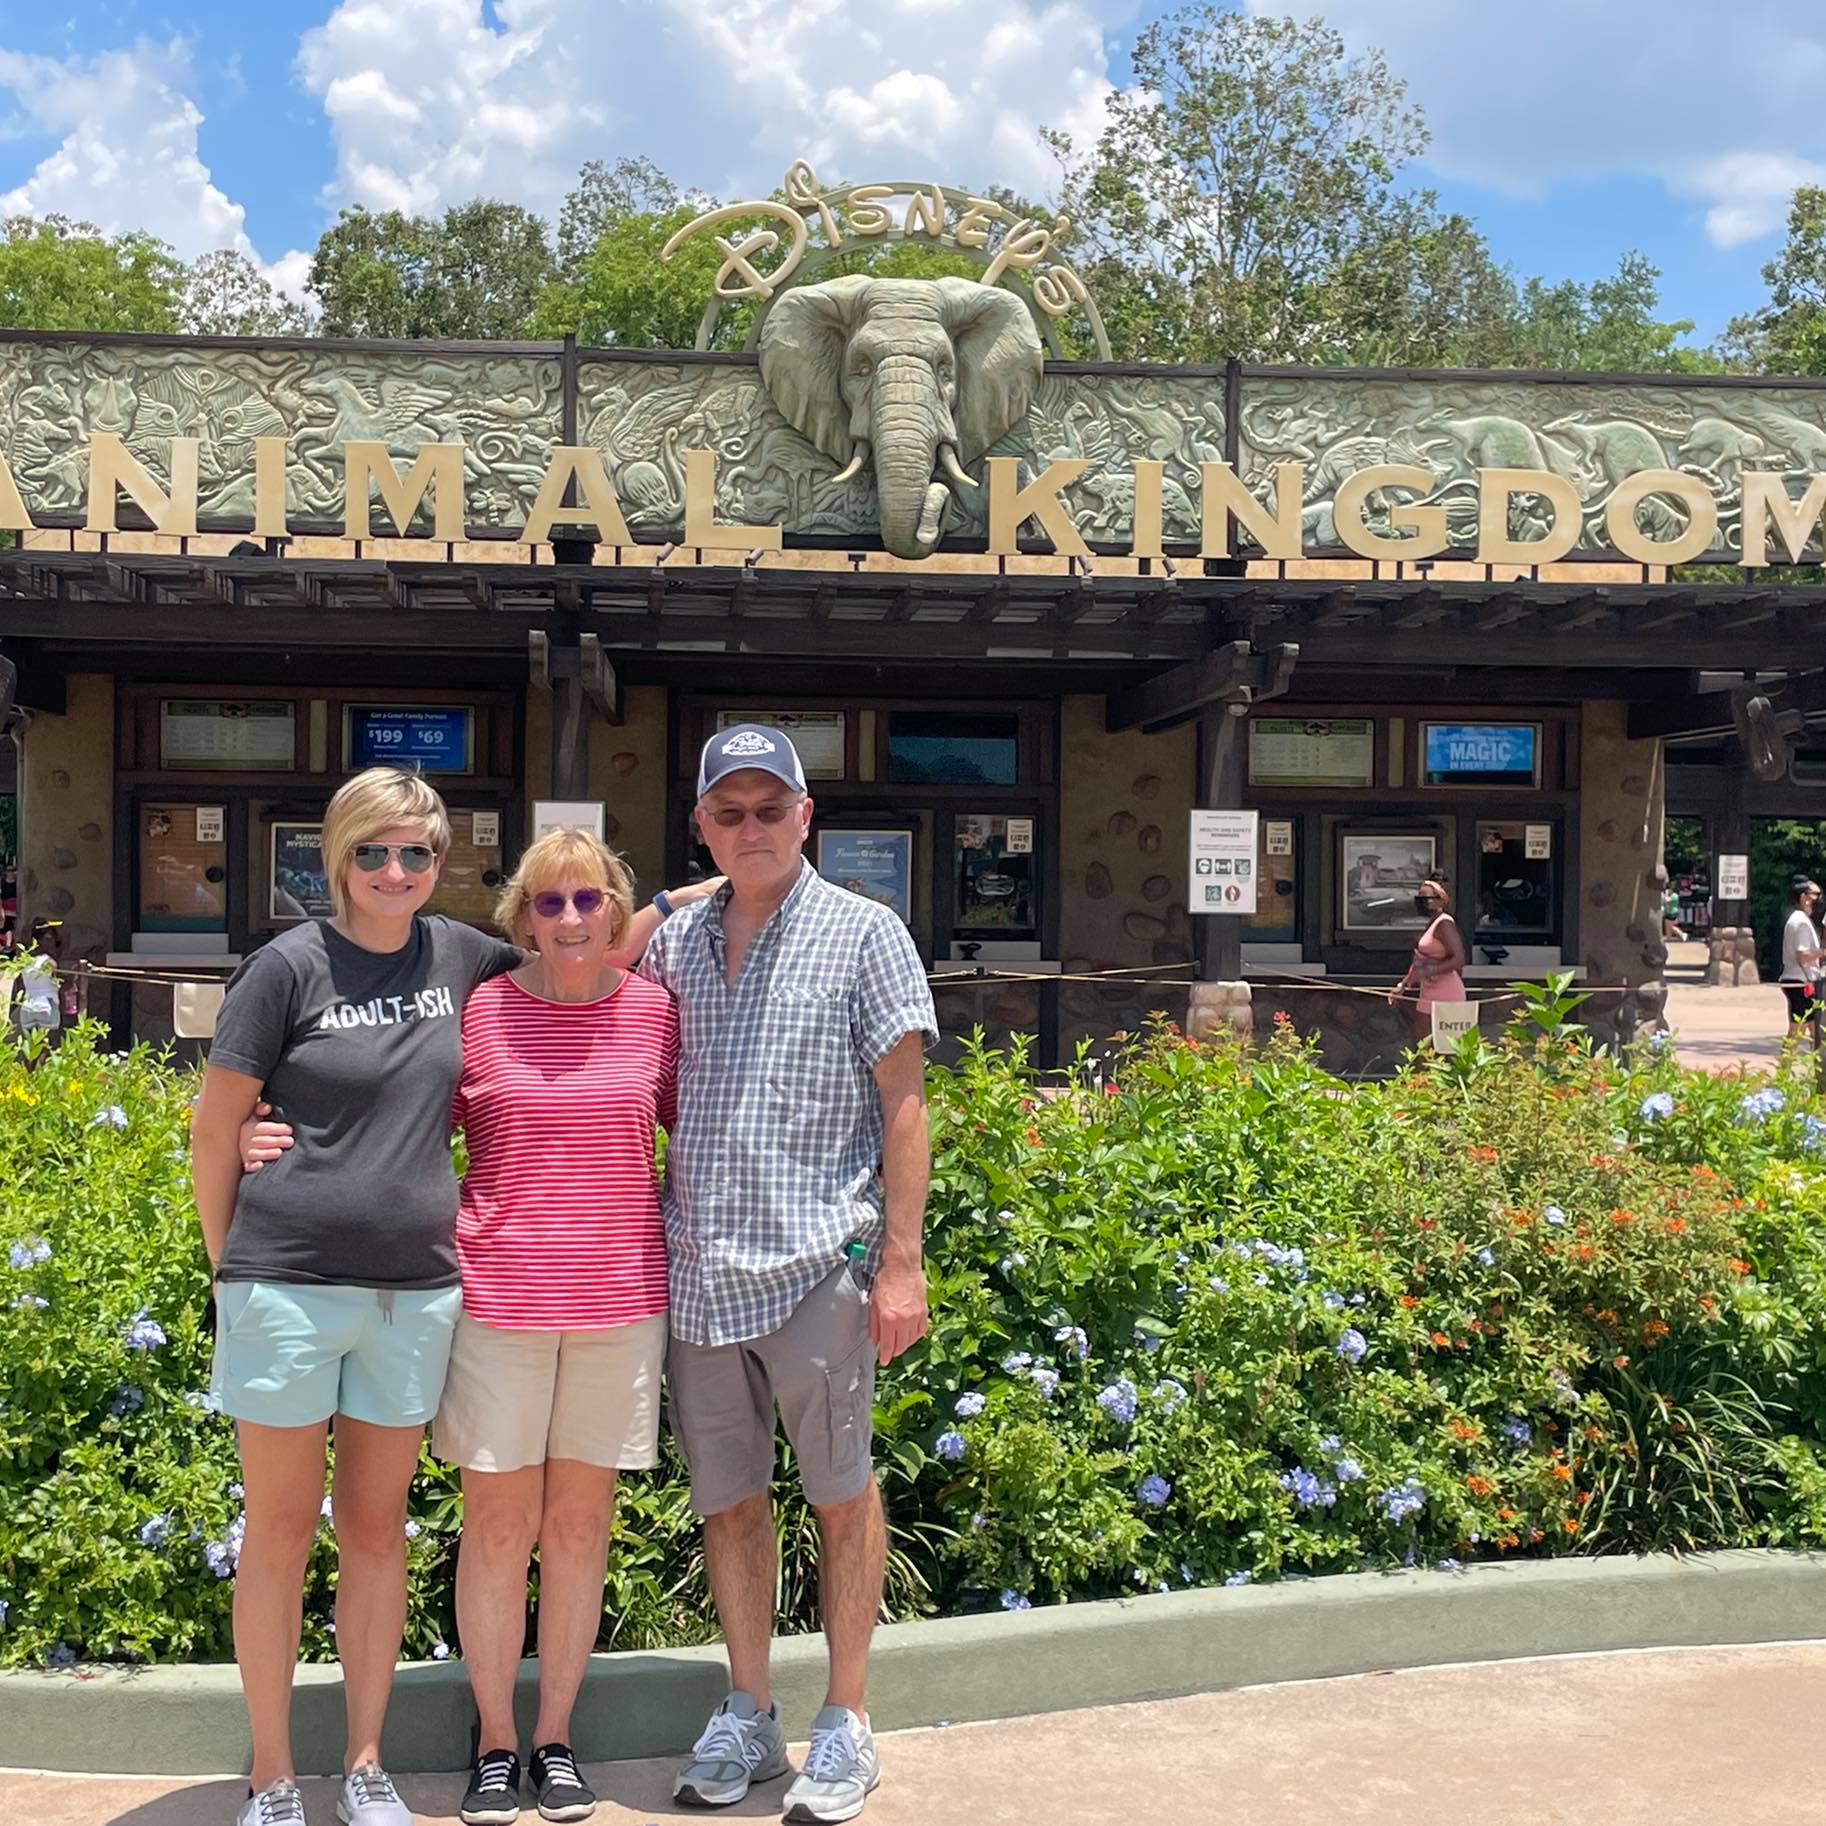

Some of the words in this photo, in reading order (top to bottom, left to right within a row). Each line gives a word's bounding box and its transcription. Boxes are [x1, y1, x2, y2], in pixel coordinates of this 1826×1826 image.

[985, 456, 1826, 568] KINGDOM
[368, 729, 403, 743] $199
[418, 730, 444, 744] $69
[1449, 742, 1511, 762] MAGIC
[320, 986, 454, 1029] ADULT-ISH
[1439, 1021, 1471, 1030] ENTER
